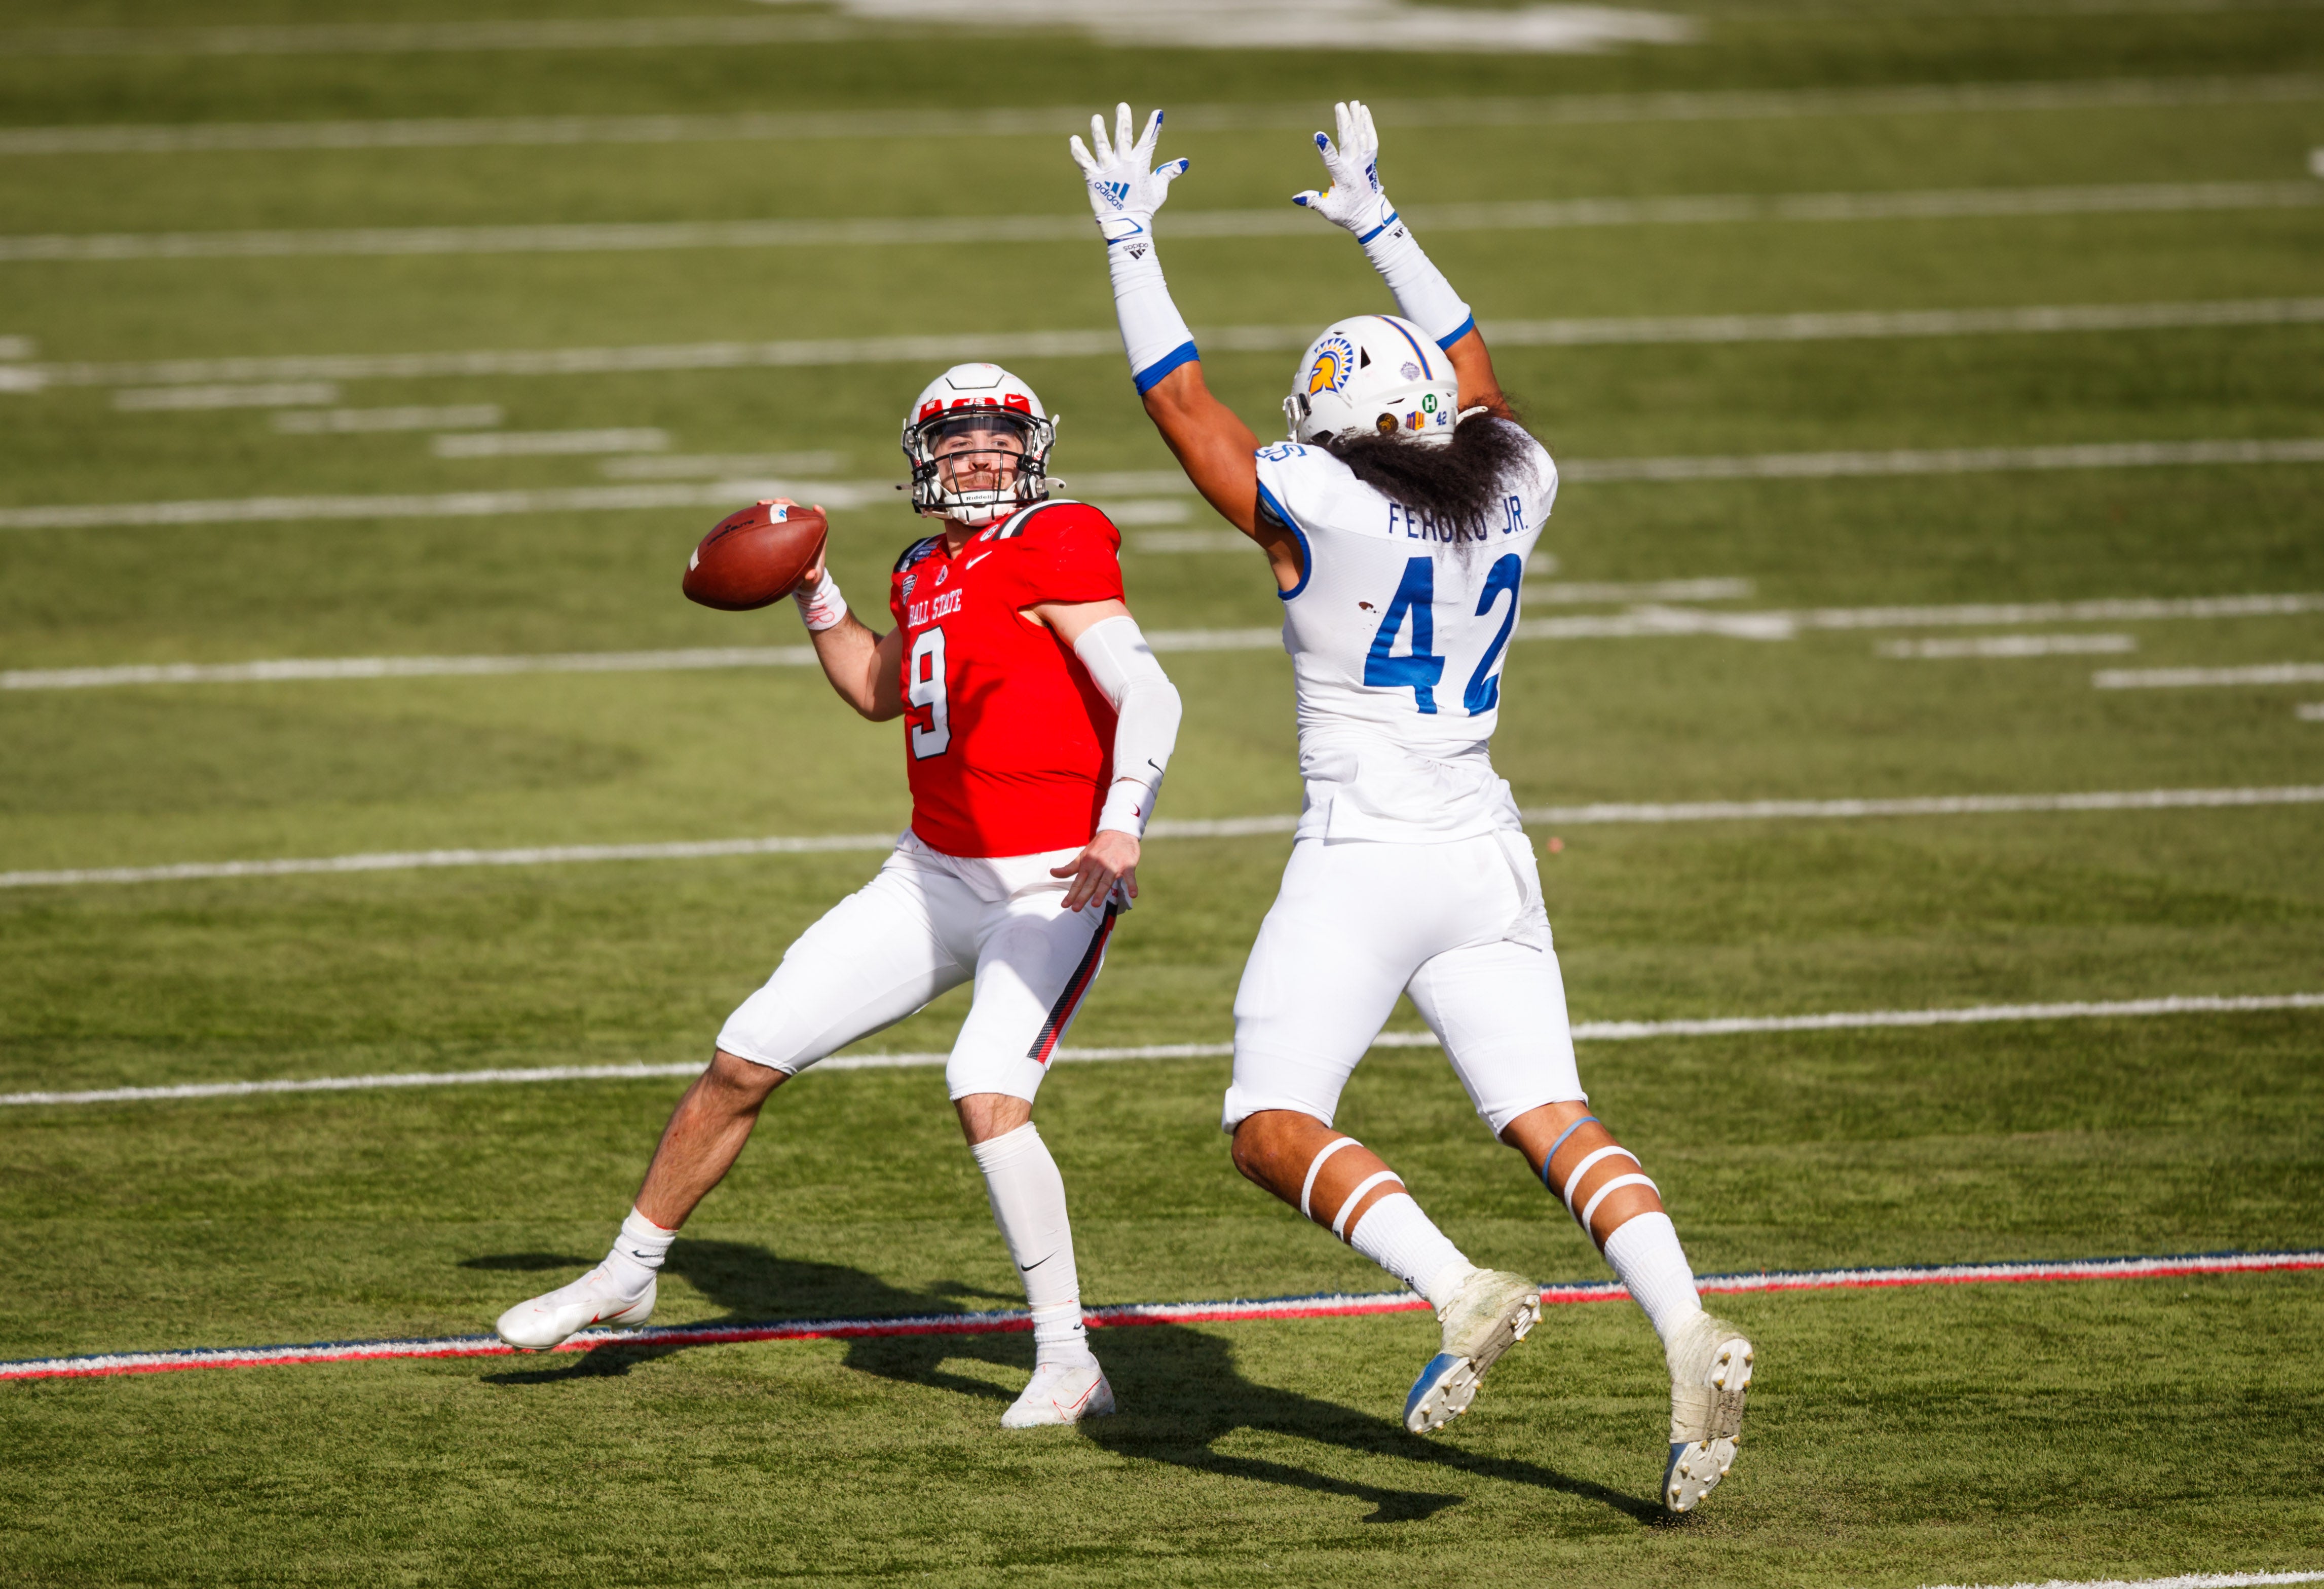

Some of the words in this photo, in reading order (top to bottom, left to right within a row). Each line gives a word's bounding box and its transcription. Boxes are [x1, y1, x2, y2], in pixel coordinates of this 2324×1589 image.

[1095, 182, 1124, 210] adidas
[1123, 243, 1149, 251] adidas
[1425, 397, 1436, 411] H
[1436, 411, 1447, 426] 42
[1502, 495, 1528, 534] JR.
[908, 600, 929, 628] BALL
[931, 588, 962, 620] STATE
[1363, 553, 1522, 717] 42
[909, 624, 952, 761] 9
